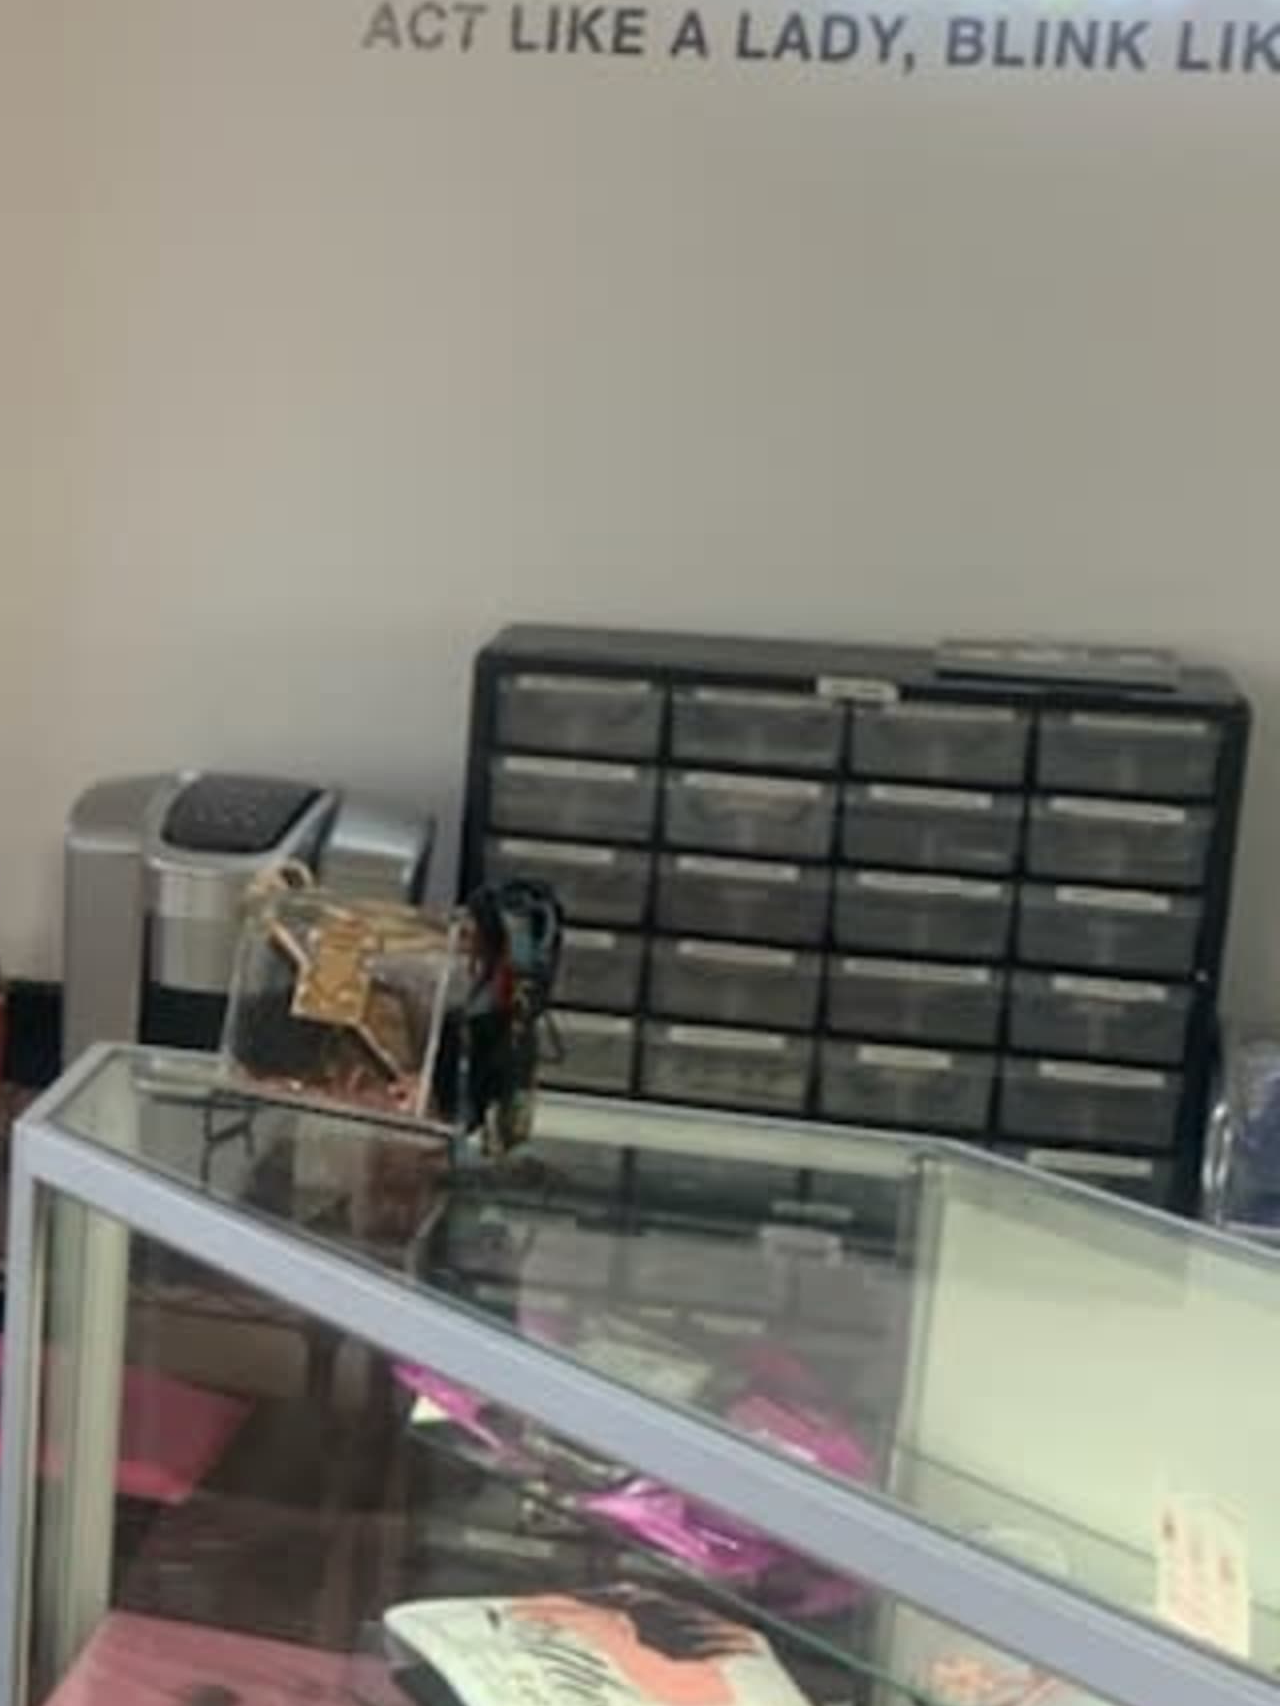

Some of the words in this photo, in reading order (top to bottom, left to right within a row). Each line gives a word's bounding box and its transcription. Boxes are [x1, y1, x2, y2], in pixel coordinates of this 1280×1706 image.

[360, 0, 488, 52] ACT
[509, 3, 646, 56] LIKE
[670, 8, 709, 60] A
[735, 11, 916, 76] LADY,
[946, 16, 1151, 72] BLINK
